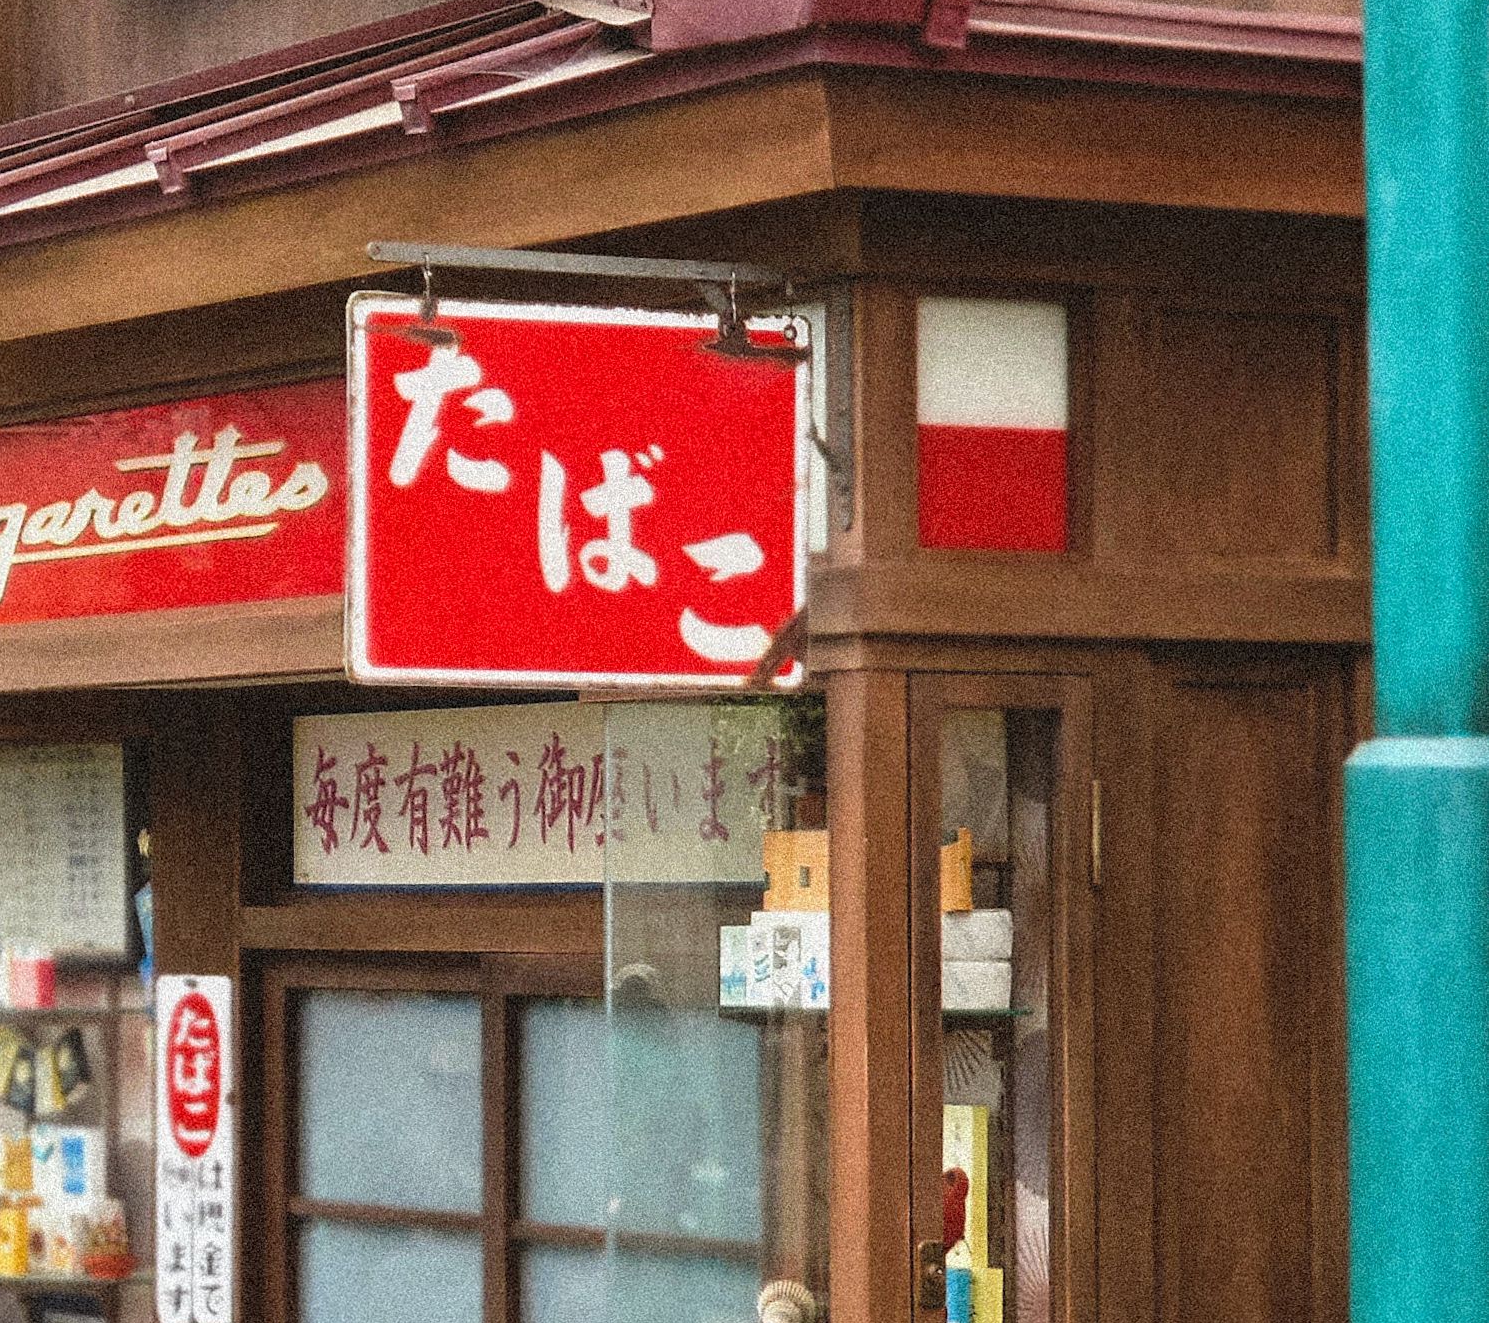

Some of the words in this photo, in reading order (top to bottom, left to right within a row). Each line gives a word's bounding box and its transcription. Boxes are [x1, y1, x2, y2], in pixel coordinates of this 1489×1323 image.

[390, 342, 771, 664] たばこ
[173, 1005, 217, 1145] たばこ
